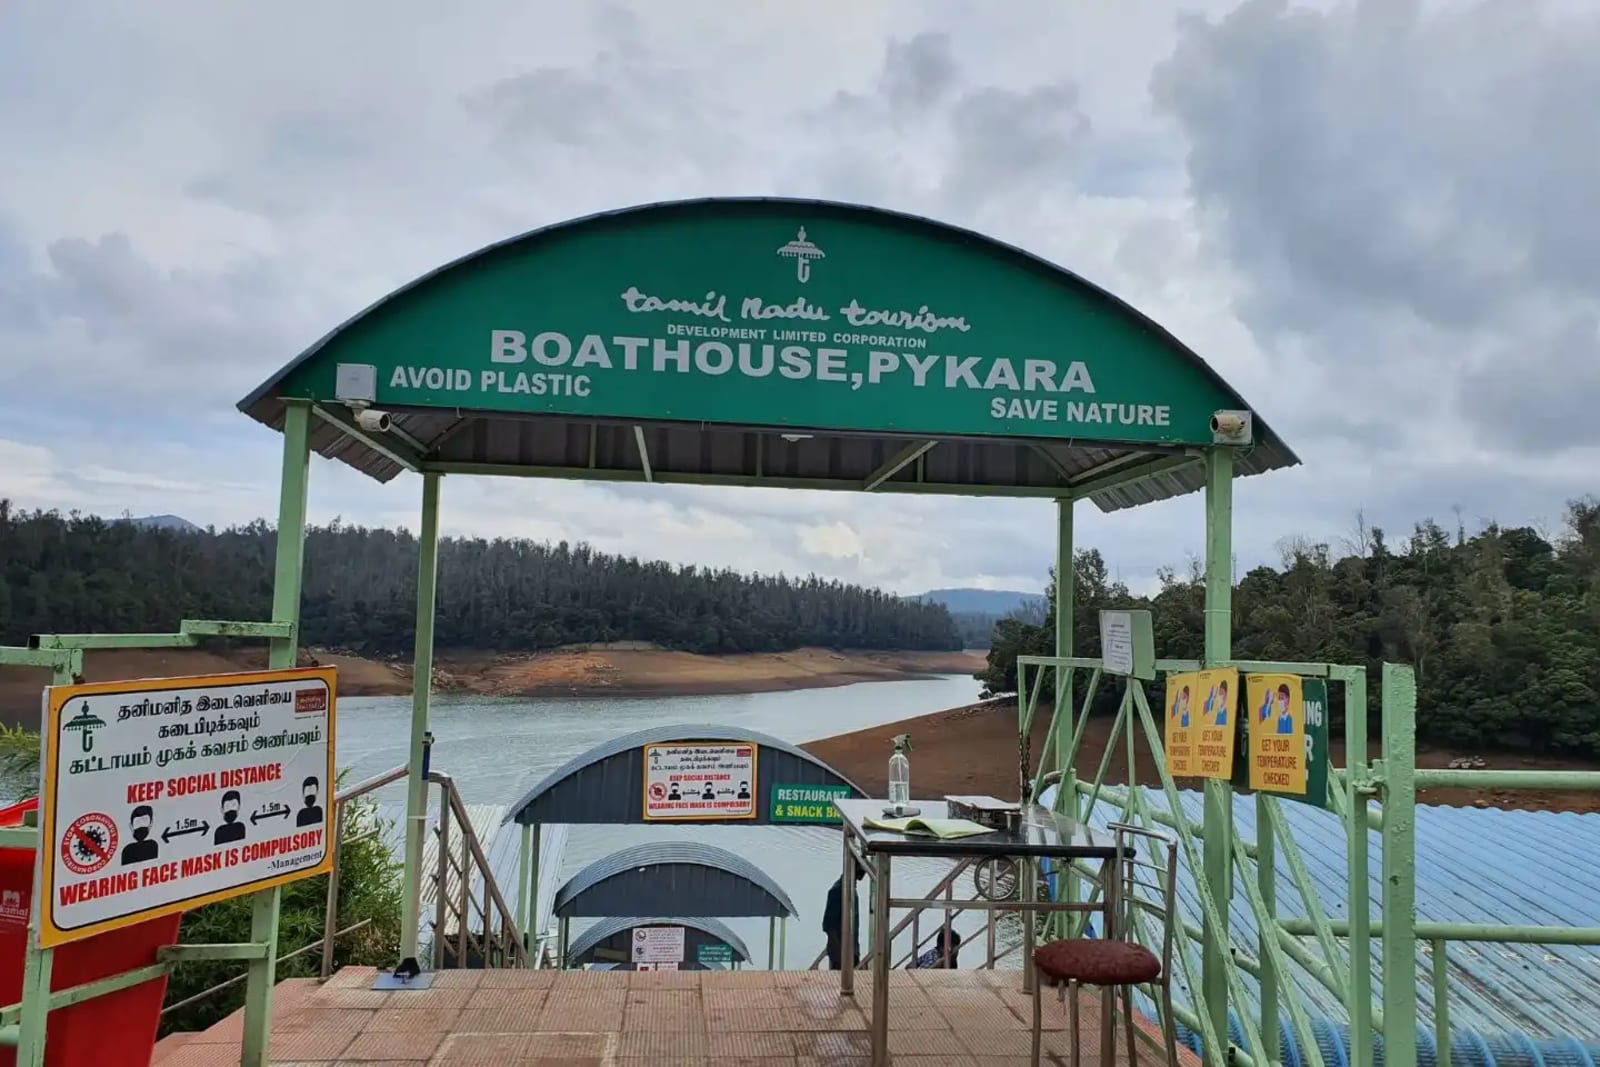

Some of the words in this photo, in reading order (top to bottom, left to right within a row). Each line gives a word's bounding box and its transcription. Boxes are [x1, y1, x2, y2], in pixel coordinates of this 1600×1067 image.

[621, 286, 732, 322] tamil
[840, 299, 971, 333] tourism
[667, 324, 767, 340] DEVELOPMENT
[773, 329, 827, 343] LIMITED
[833, 332, 927, 349] CORPORATION
[390, 365, 472, 392] AVOID
[480, 369, 592, 398] PLASTIC
[990, 397, 1058, 422] SAVE
[1066, 401, 1171, 427] NATURE
[1261, 738, 1271, 752] GET
[1273, 739, 1290, 753] YOUR
[1256, 755, 1297, 770] TEMPERATURE
[127, 781, 164, 804] KEEP
[167, 773, 218, 798] SOCIAL
[220, 763, 282, 790] DISTANCE
[1263, 772, 1290, 786] CHECKED
[777, 788, 848, 802] RESTAURANT
[262, 802, 281, 814] 1.5m
[775, 804, 784, 816] &
[786, 804, 823, 818] SNACK
[176, 817, 198, 831] 1.5m
[59, 870, 138, 907] WEARING
[142, 862, 179, 886] FACE
[181, 855, 222, 879] MASK
[225, 850, 239, 868] IS
[241, 829, 324, 863] COMPULSORY
